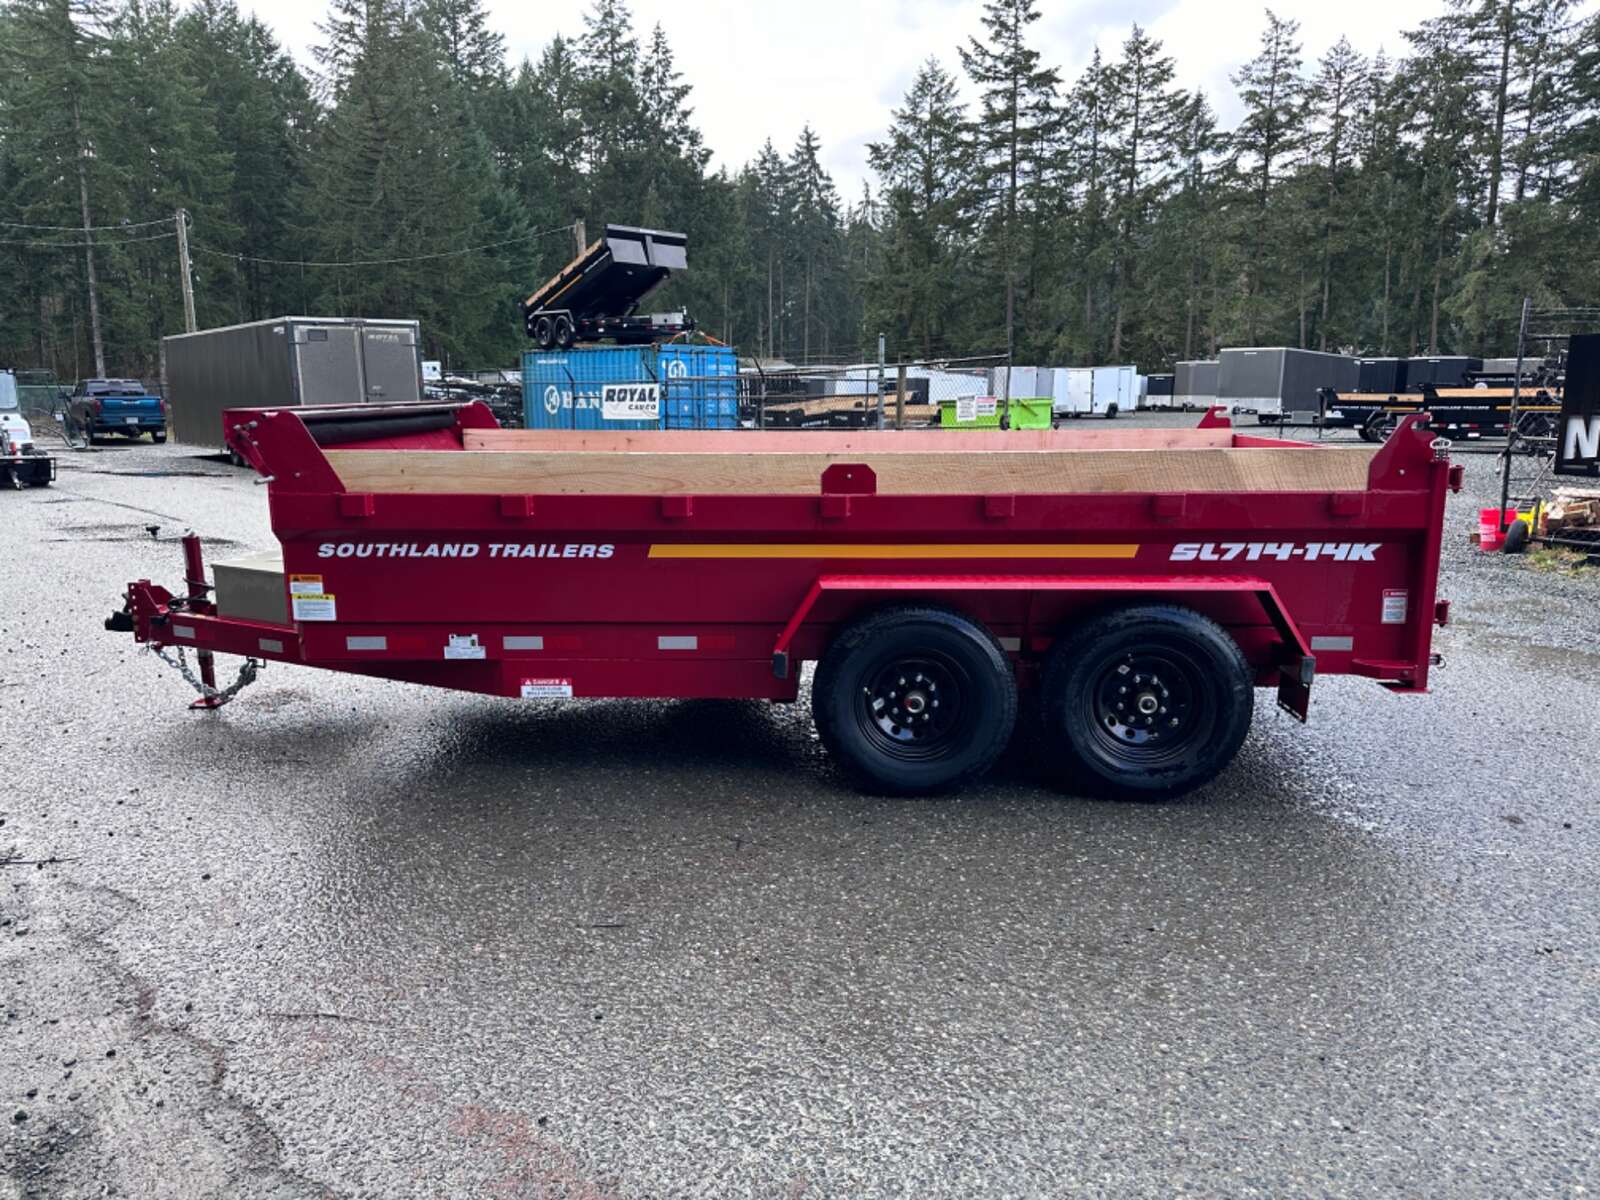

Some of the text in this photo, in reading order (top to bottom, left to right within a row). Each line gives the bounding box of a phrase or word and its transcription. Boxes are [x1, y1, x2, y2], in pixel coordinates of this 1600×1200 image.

[561, 390, 603, 410] HAN
[605, 388, 657, 402] ROYAL
[317, 543, 616, 558] SOUTHLAND TRAILERS
[1168, 542, 1382, 562] SL714-14K
